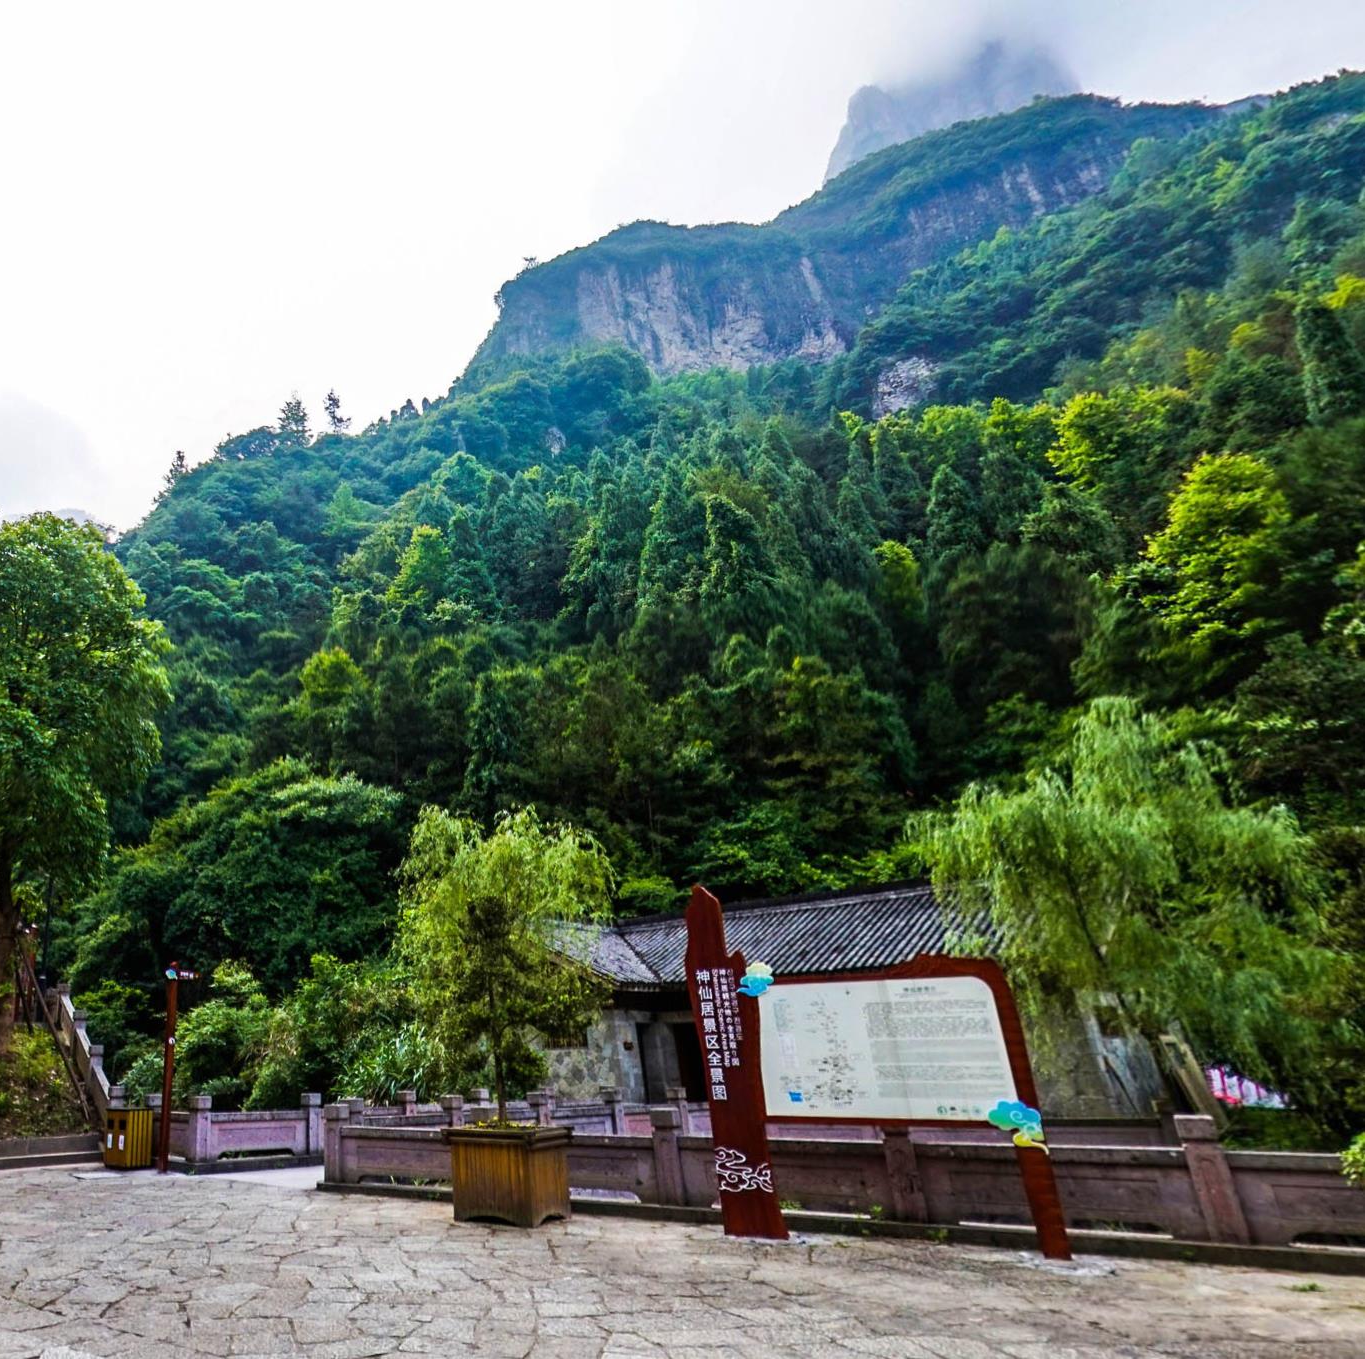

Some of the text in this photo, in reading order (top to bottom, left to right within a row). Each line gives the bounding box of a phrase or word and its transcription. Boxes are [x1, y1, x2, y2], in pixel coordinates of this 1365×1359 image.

[696, 969, 727, 1101] 神仙居景区全景图
[717, 1008, 726, 1033] Scenic
[723, 1051, 731, 1067] Map
